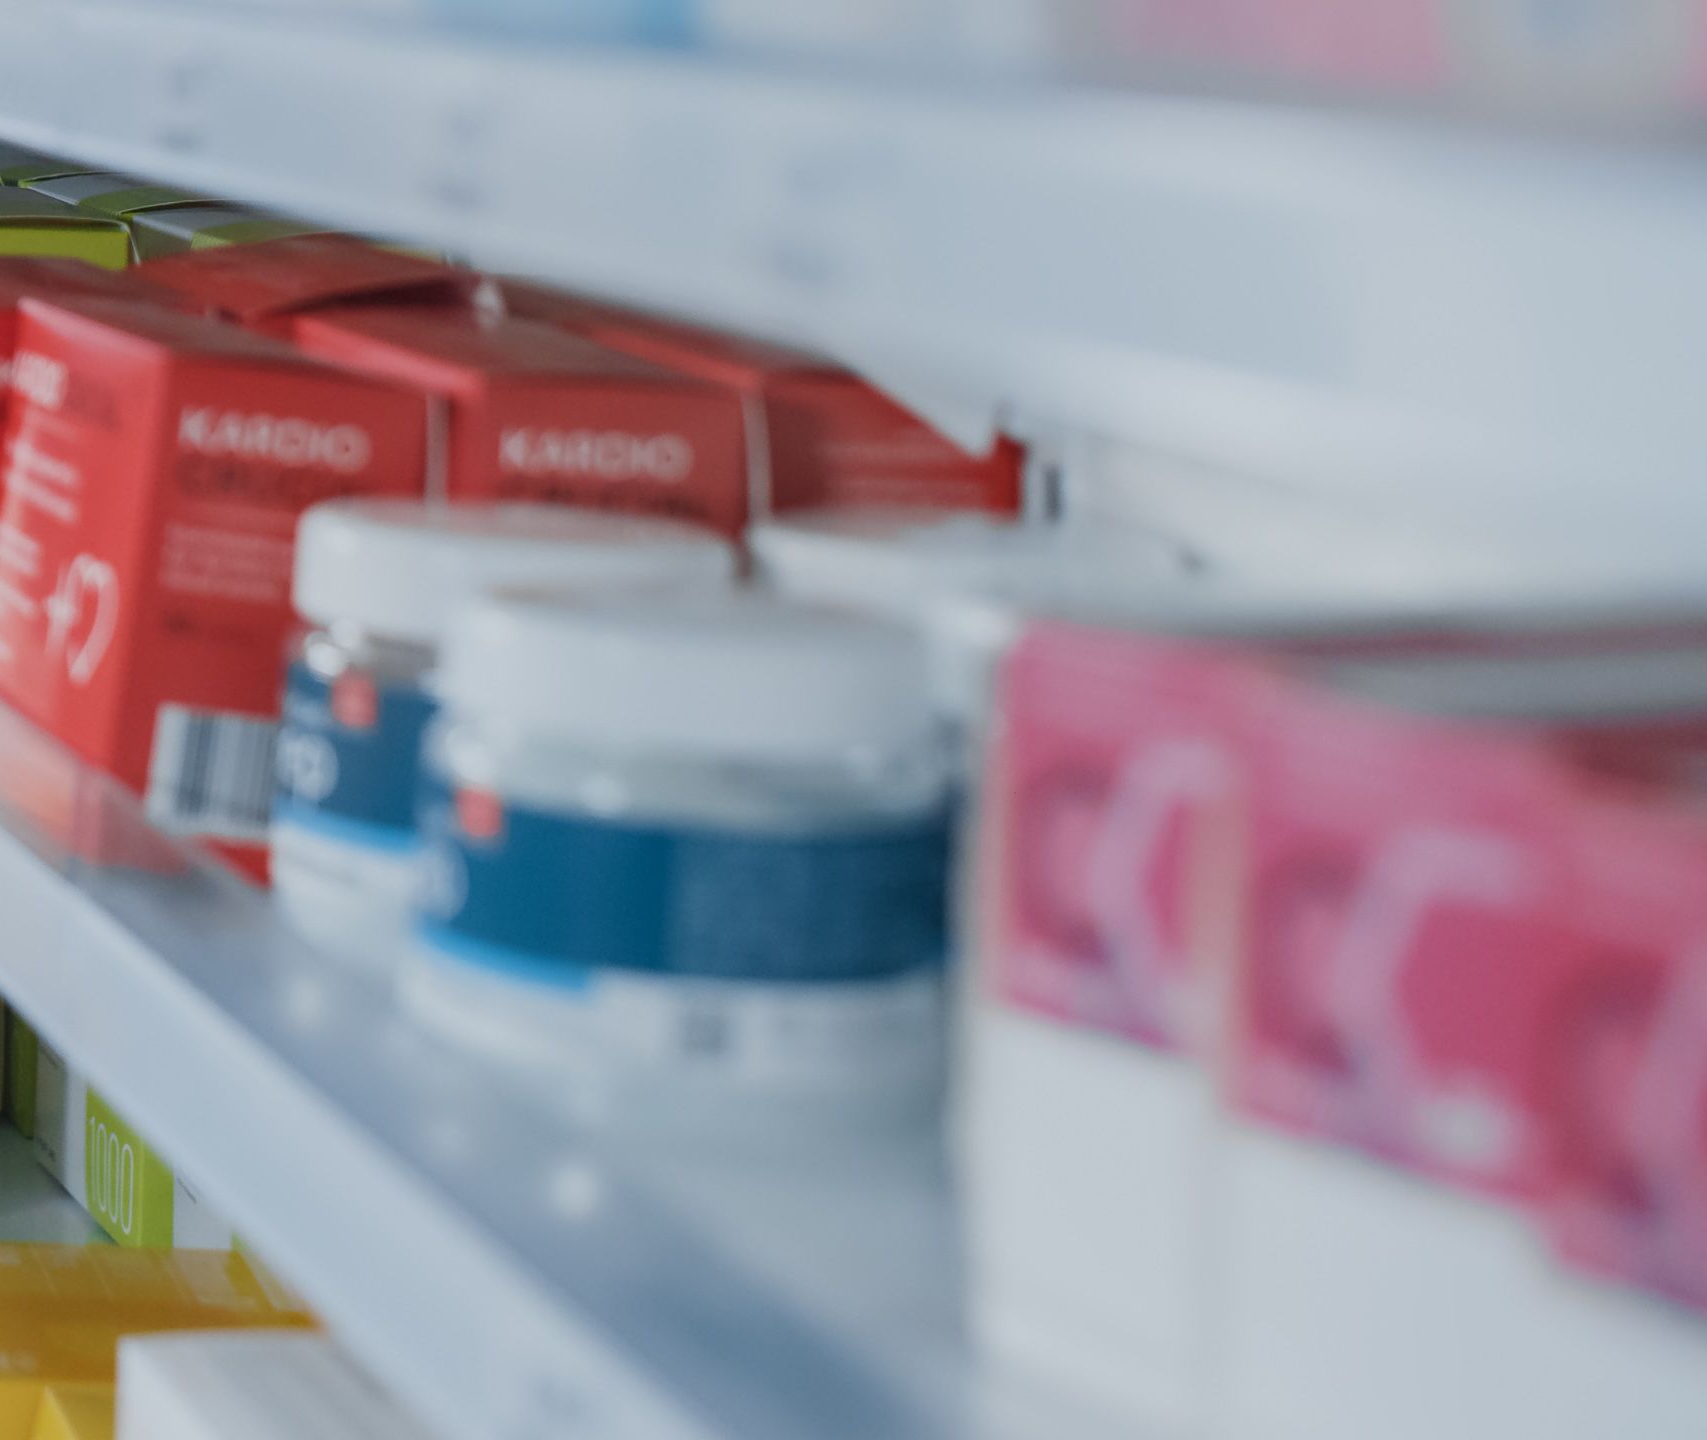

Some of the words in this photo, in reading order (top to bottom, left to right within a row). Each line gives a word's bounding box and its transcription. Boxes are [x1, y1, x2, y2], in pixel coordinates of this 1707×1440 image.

[179, 408, 370, 472] KARDIO
[500, 427, 692, 482] KARDIO
[89, 1116, 135, 1236] 1000
